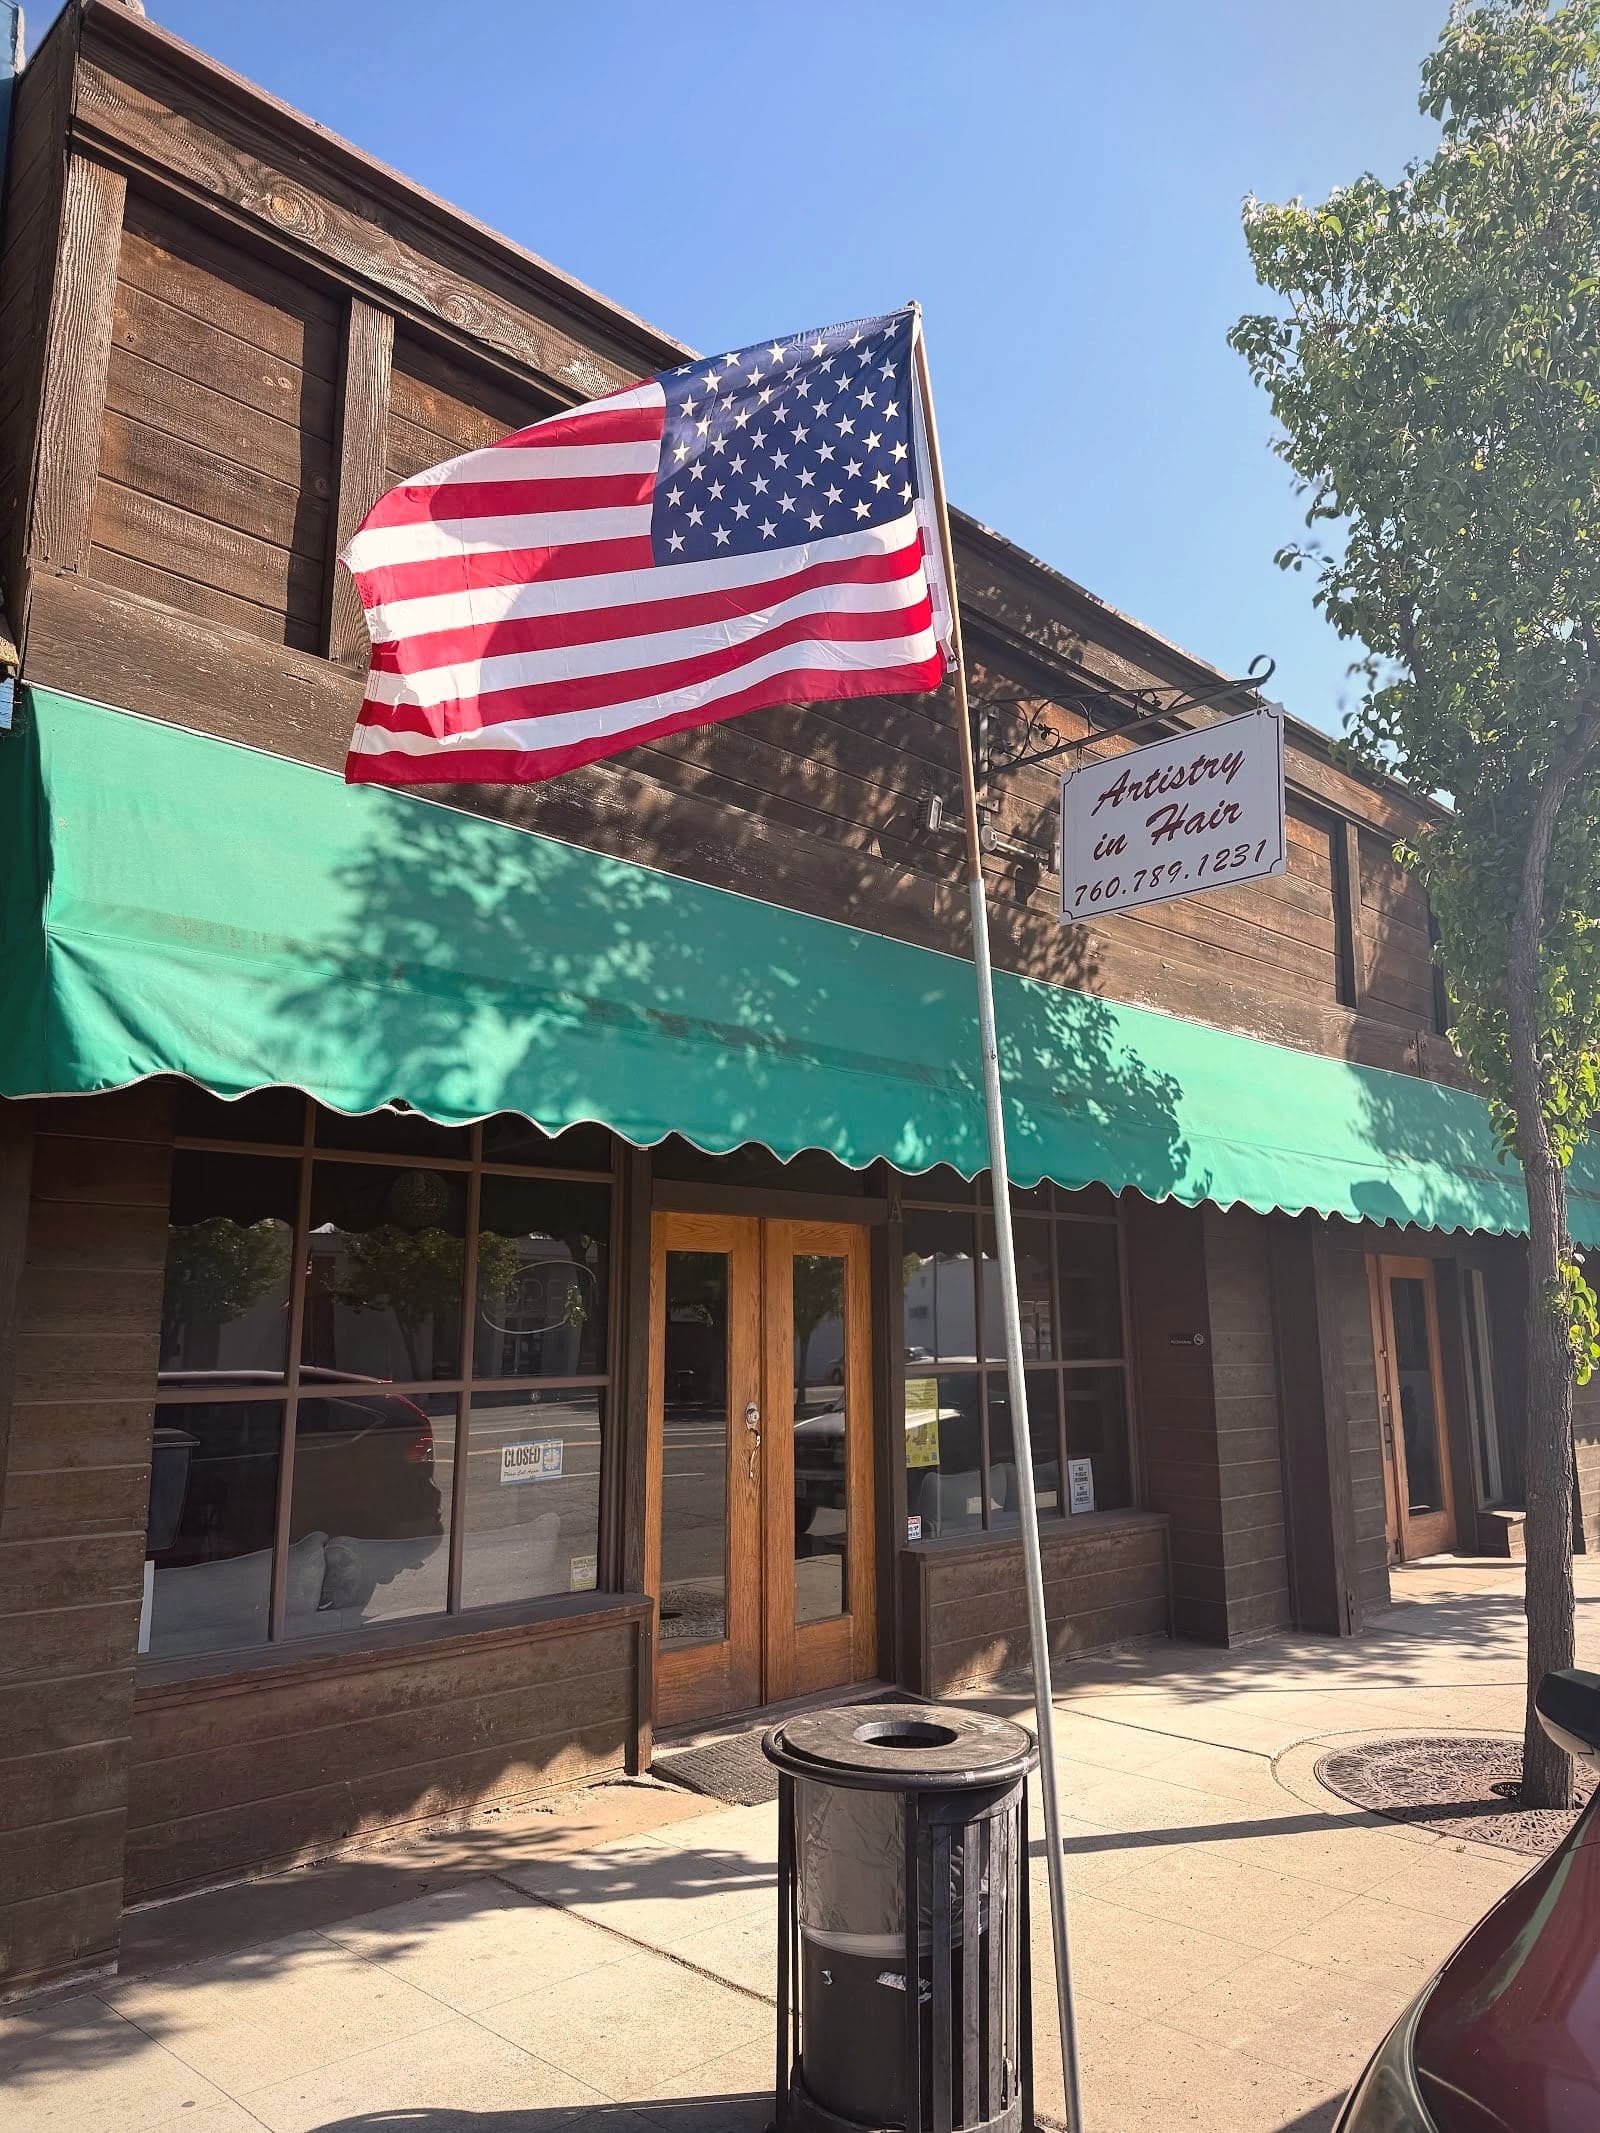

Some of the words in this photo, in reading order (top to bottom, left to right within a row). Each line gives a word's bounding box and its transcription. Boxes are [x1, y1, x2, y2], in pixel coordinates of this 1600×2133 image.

[1091, 750, 1245, 817] Artistry
[1093, 832, 1128, 861] in
[1145, 799, 1243, 846] Hair
[1075, 839, 1267, 907] 760.789.1231
[504, 1446, 541, 1468] CLOSED
